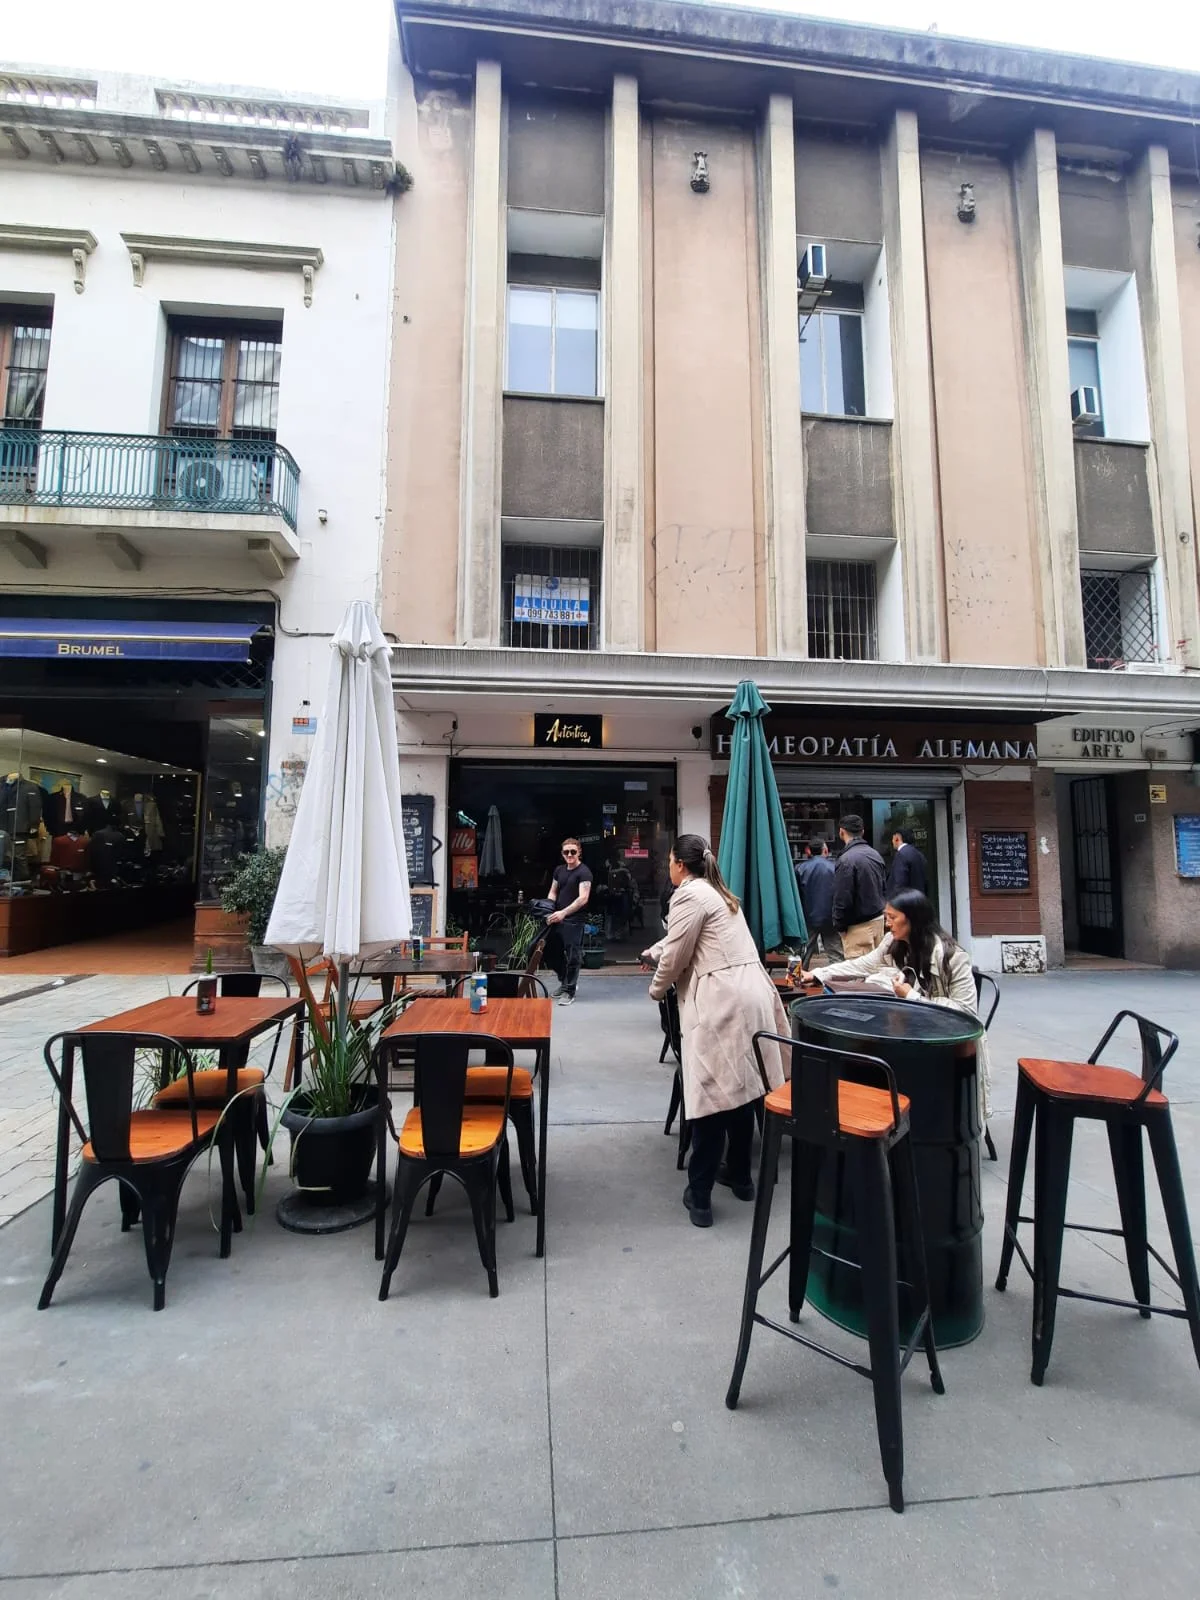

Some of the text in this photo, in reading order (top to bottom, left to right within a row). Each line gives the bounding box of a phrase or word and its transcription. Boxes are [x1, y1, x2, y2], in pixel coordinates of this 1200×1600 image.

[522, 598, 581, 611] ALQUILA
[58, 643, 125, 656] BRUMEL
[1072, 728, 1135, 743] EDIFICIO
[715, 733, 1037, 760] HMEOPATÍA ALEMANA
[1081, 744, 1124, 758] ARFE
